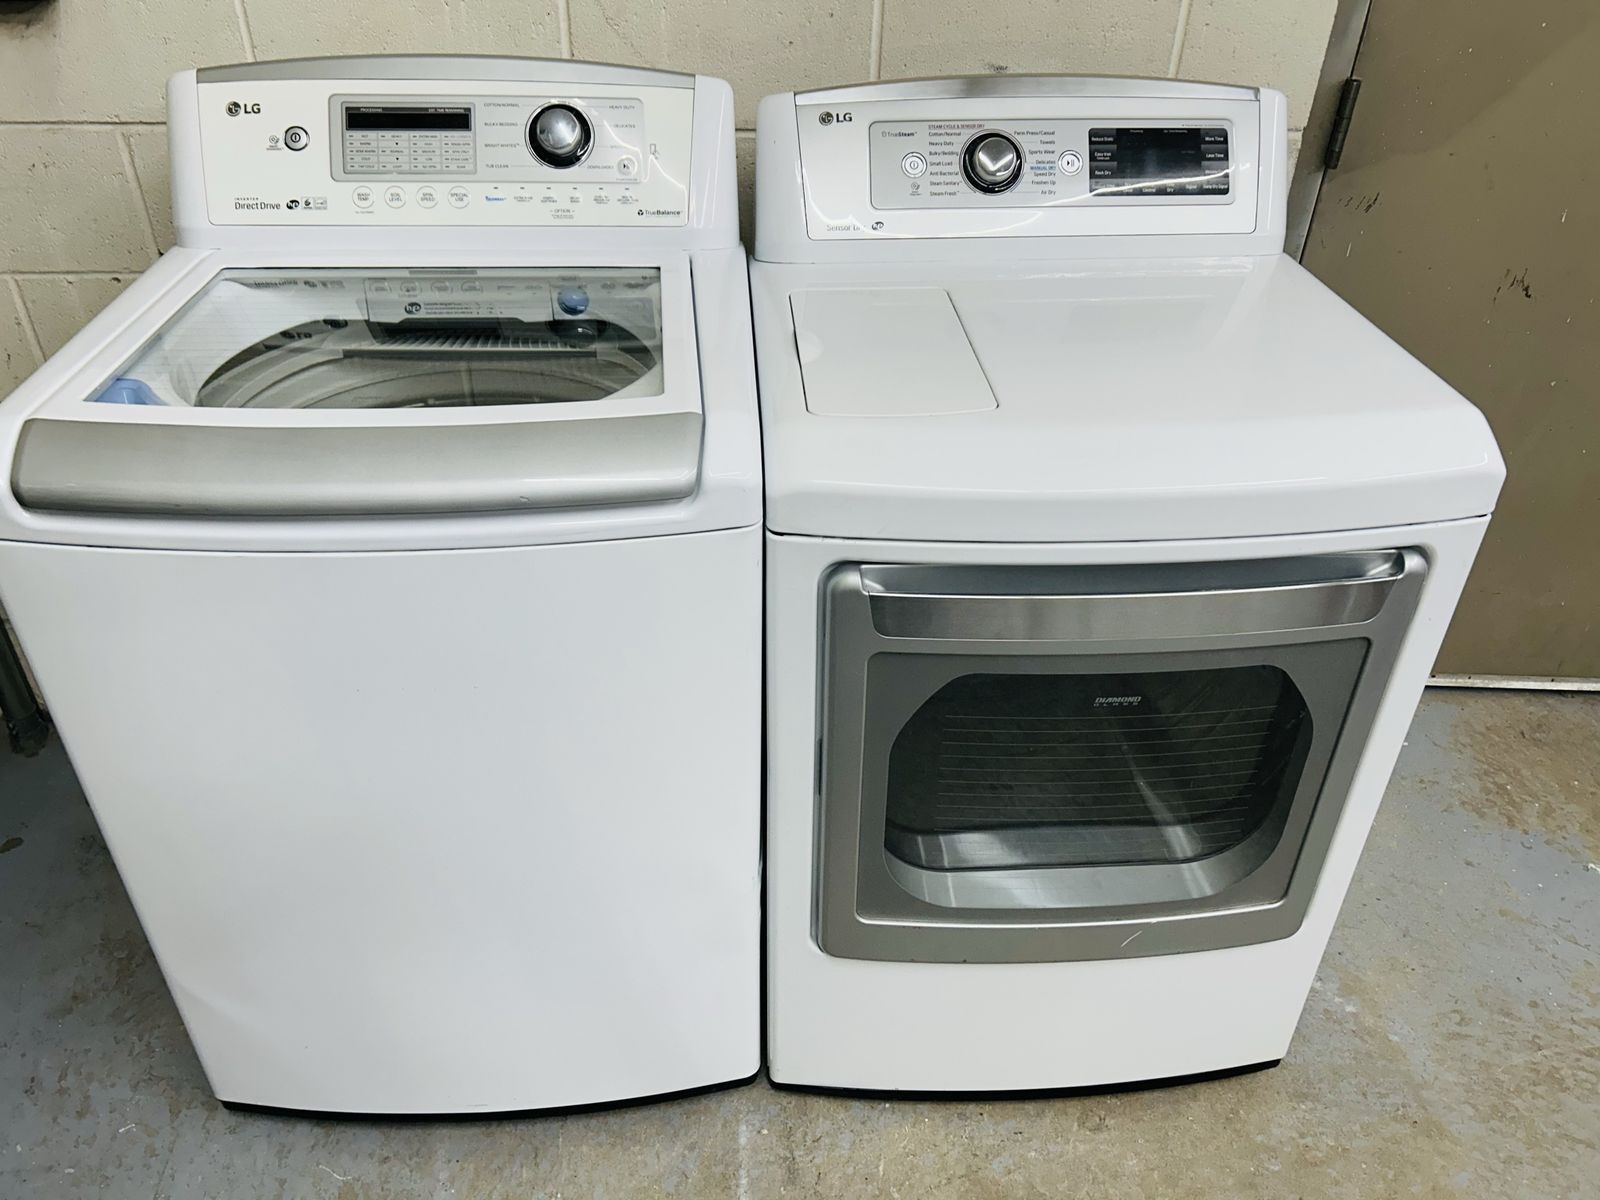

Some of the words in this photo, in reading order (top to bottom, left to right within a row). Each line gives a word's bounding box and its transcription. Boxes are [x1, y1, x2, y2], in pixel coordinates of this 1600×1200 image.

[244, 103, 261, 114] LG
[836, 112, 853, 123] LG
[234, 201, 259, 210] Direct
[260, 201, 281, 210] Drive
